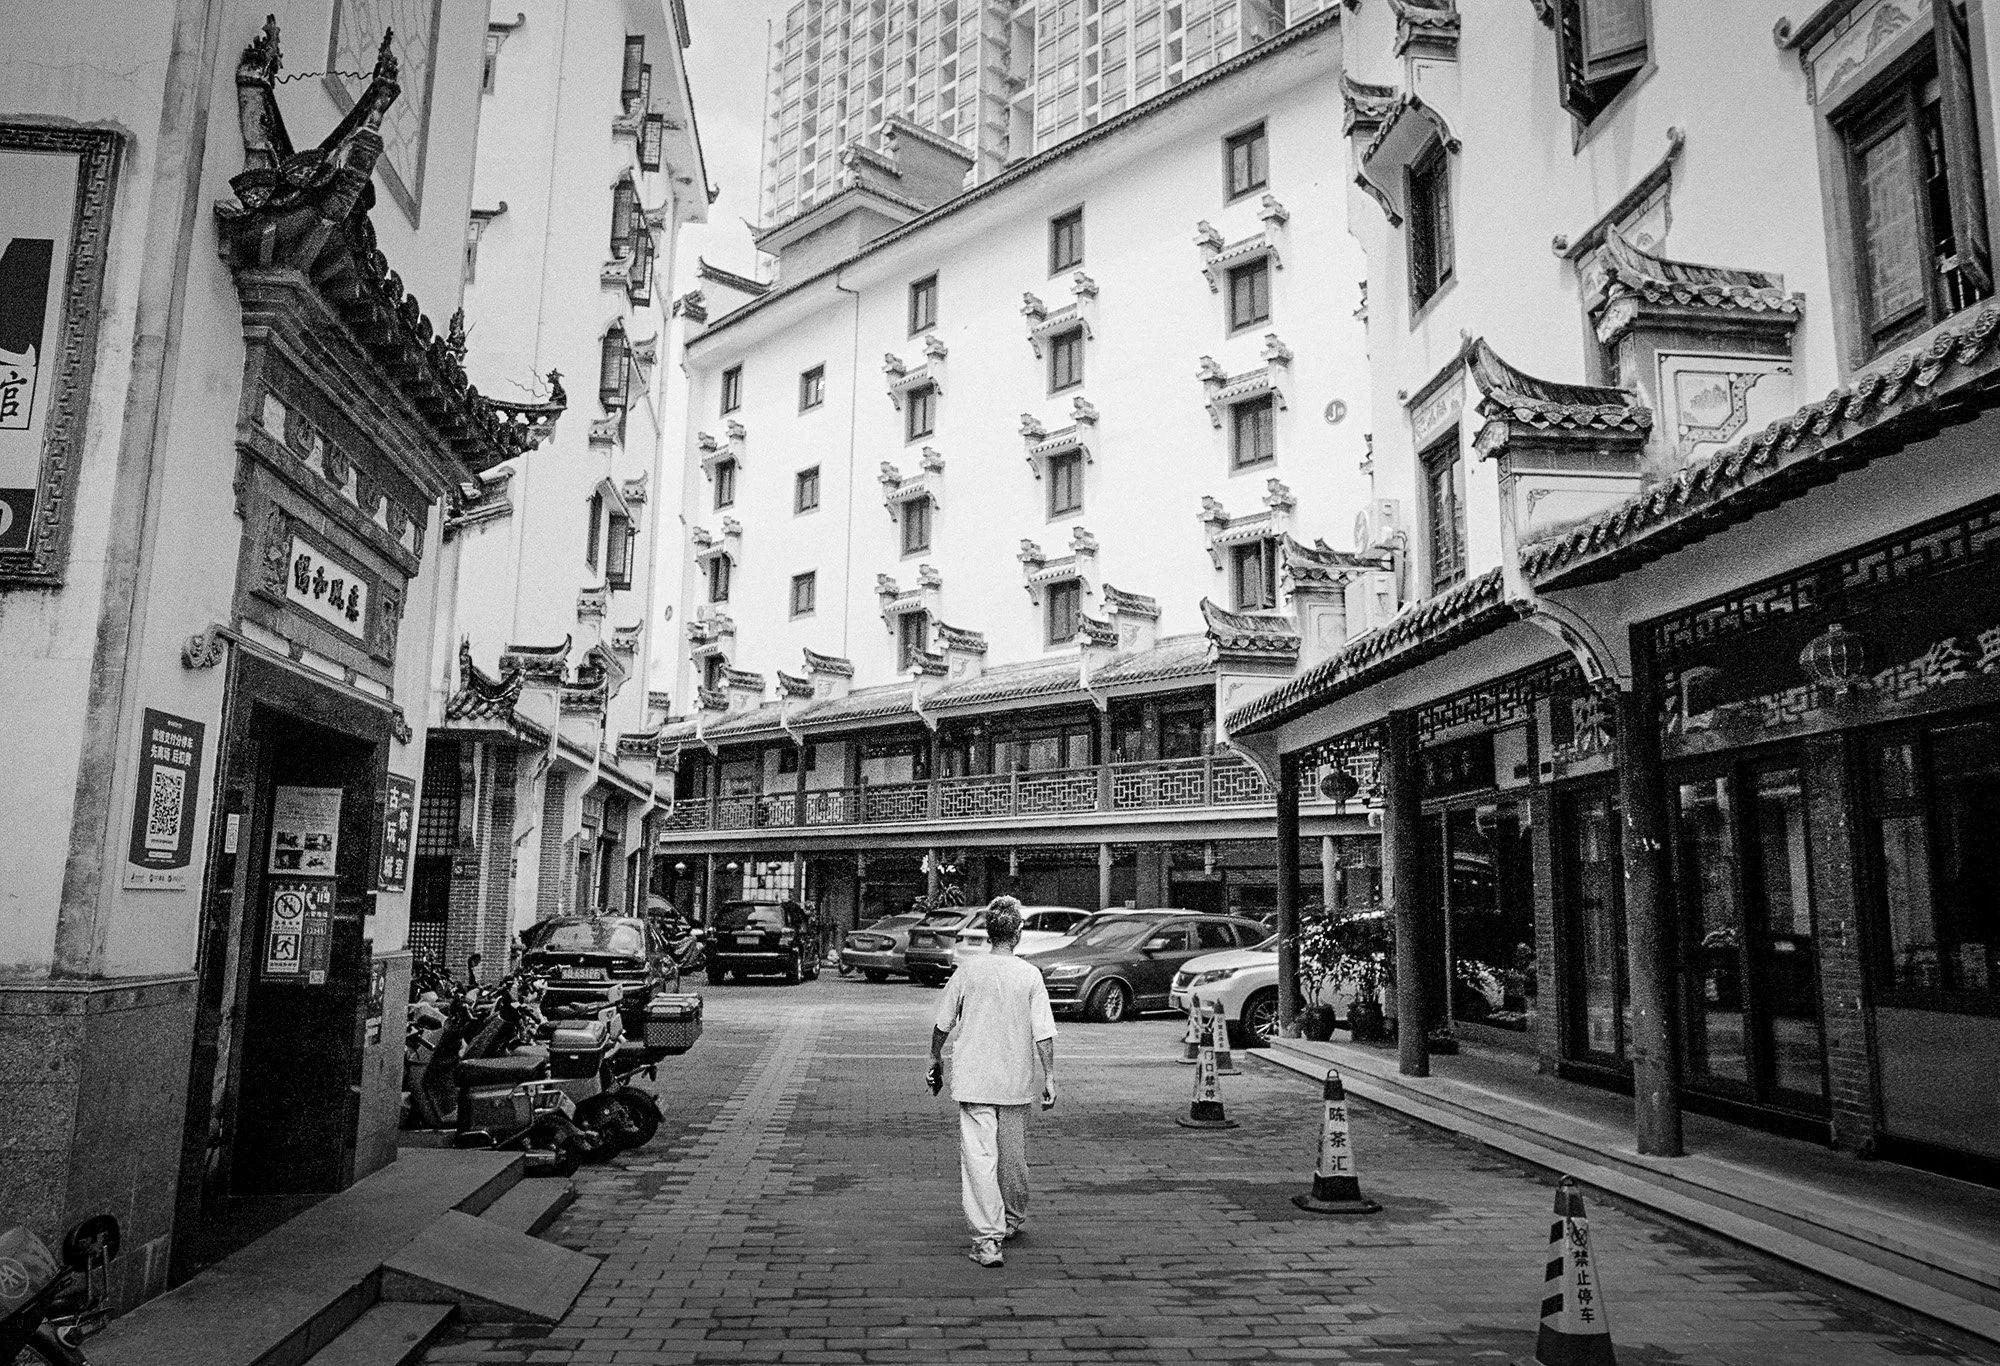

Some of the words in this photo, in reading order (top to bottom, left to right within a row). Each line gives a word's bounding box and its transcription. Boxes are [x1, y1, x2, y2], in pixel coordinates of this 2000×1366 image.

[1328, 1107, 1348, 1171] 陈茶汇
[1573, 1250, 1595, 1323] 禁止停车
